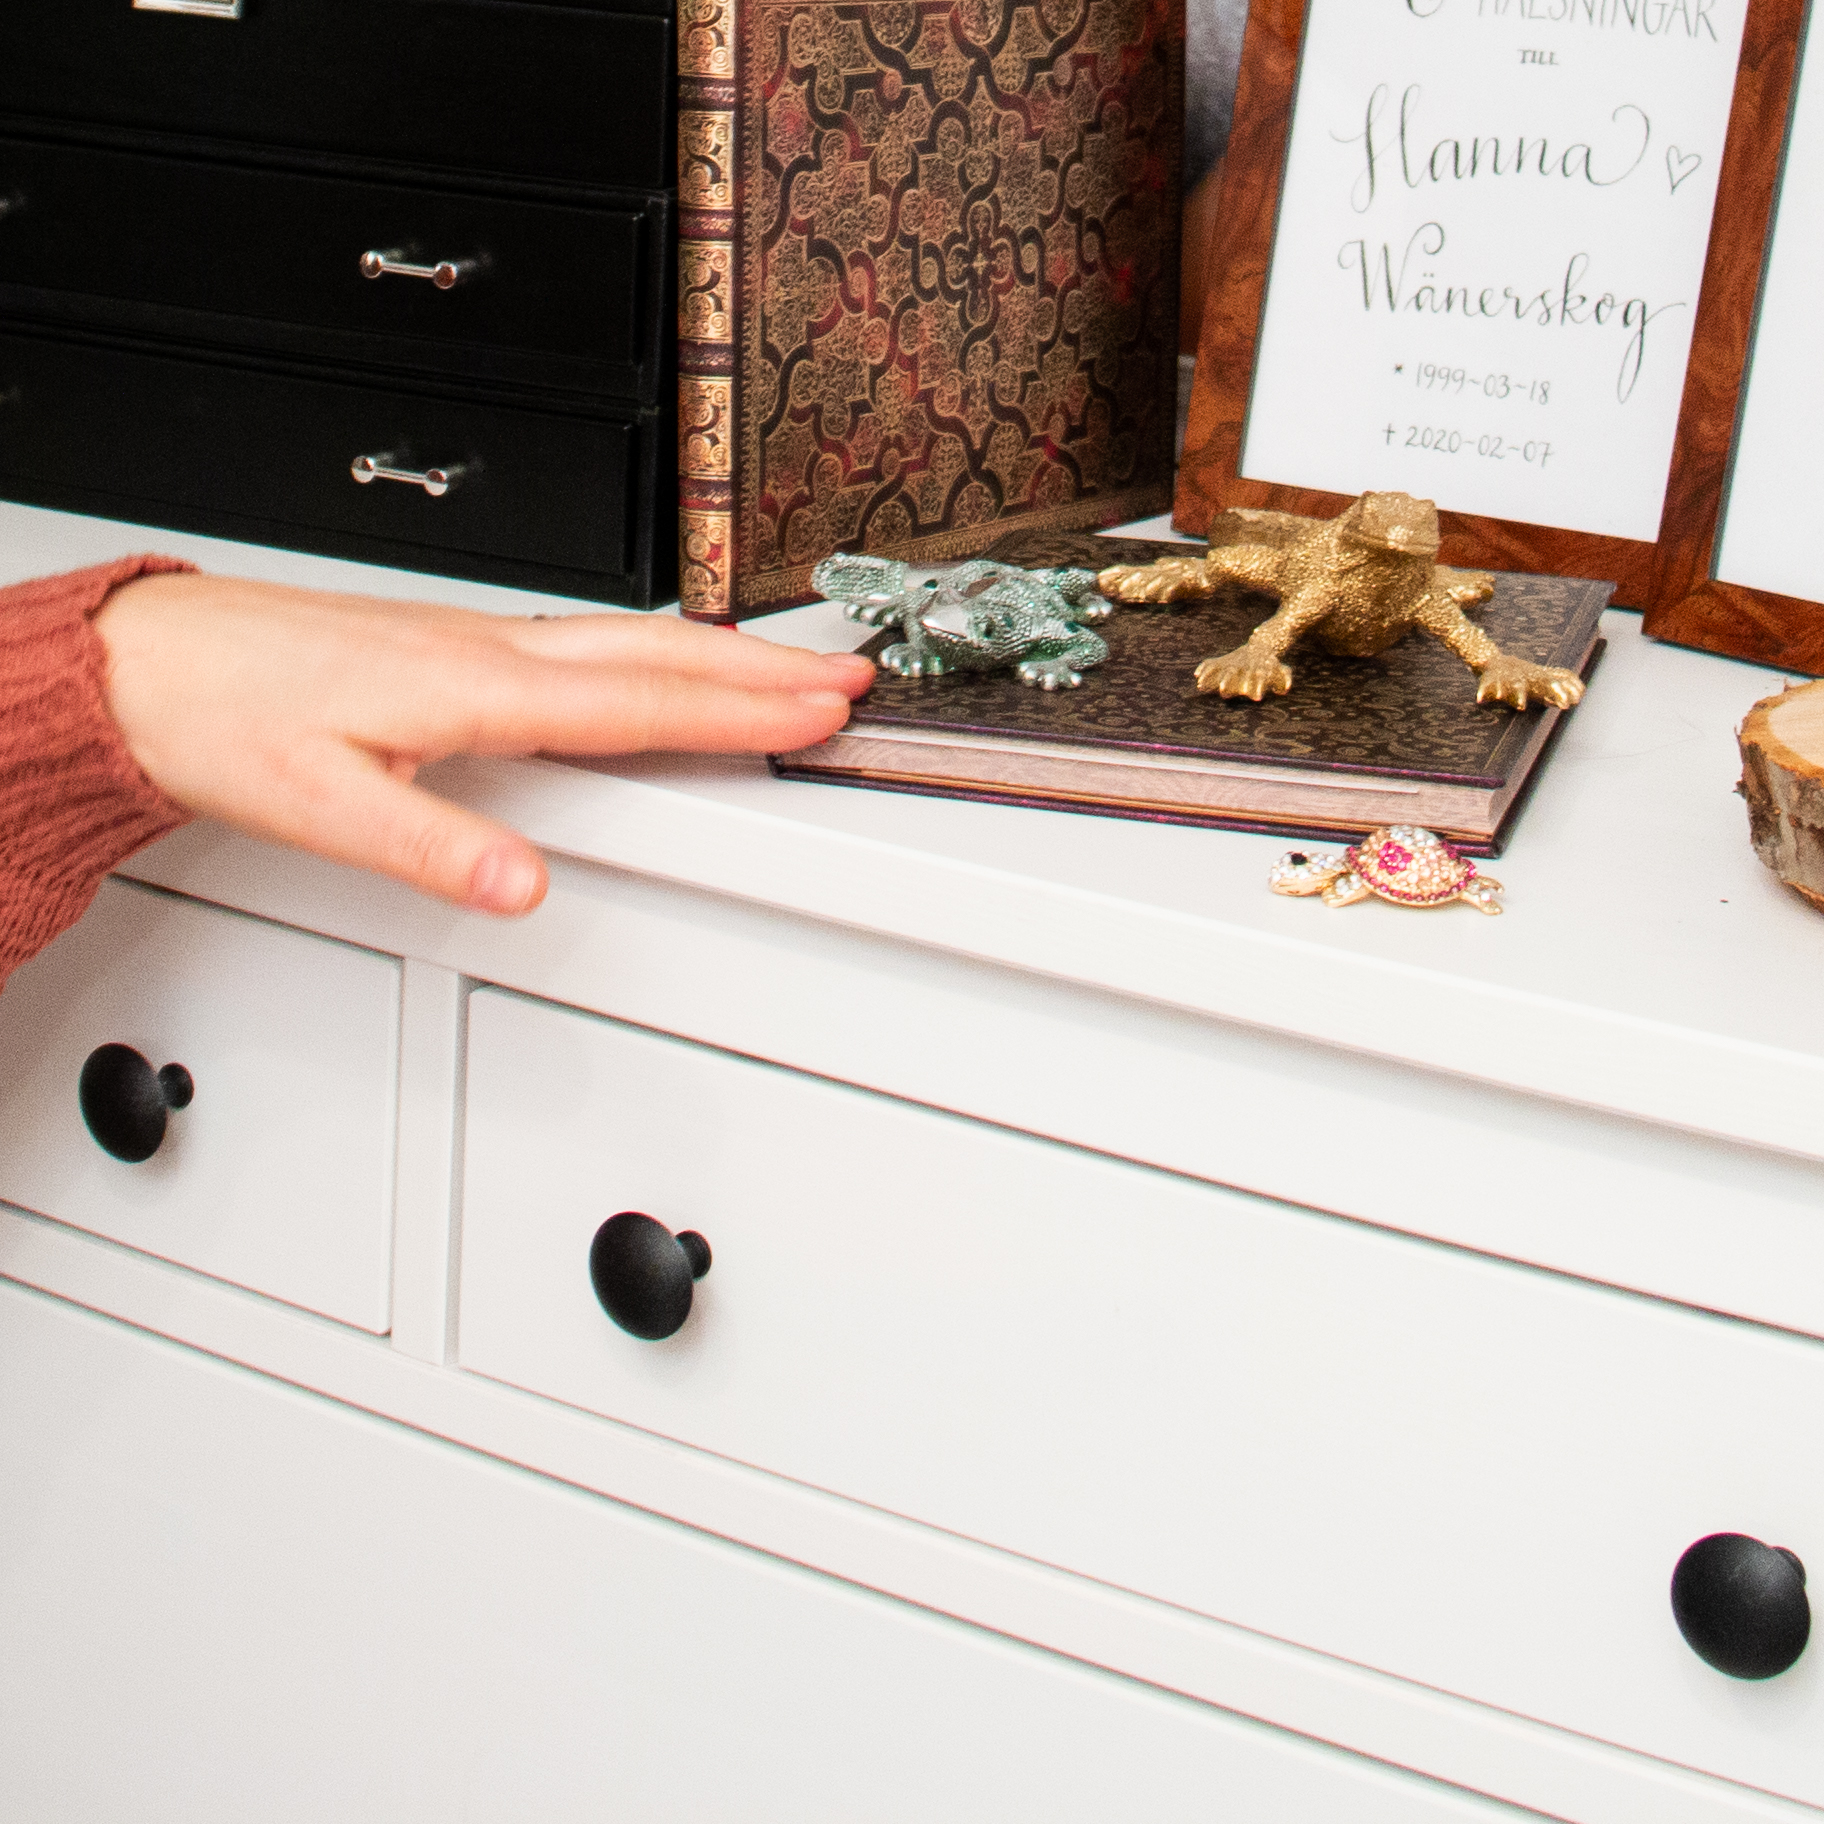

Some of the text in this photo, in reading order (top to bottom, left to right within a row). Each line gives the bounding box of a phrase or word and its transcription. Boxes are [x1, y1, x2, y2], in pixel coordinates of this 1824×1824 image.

[1517, 48, 1559, 66] TILL
[1329, 82, 1651, 214] Hanna
[1337, 221, 1687, 405] Wänerskog
[1415, 362, 1551, 406] 1999-03-18
[1404, 425, 1555, 468] 2020-02-07
